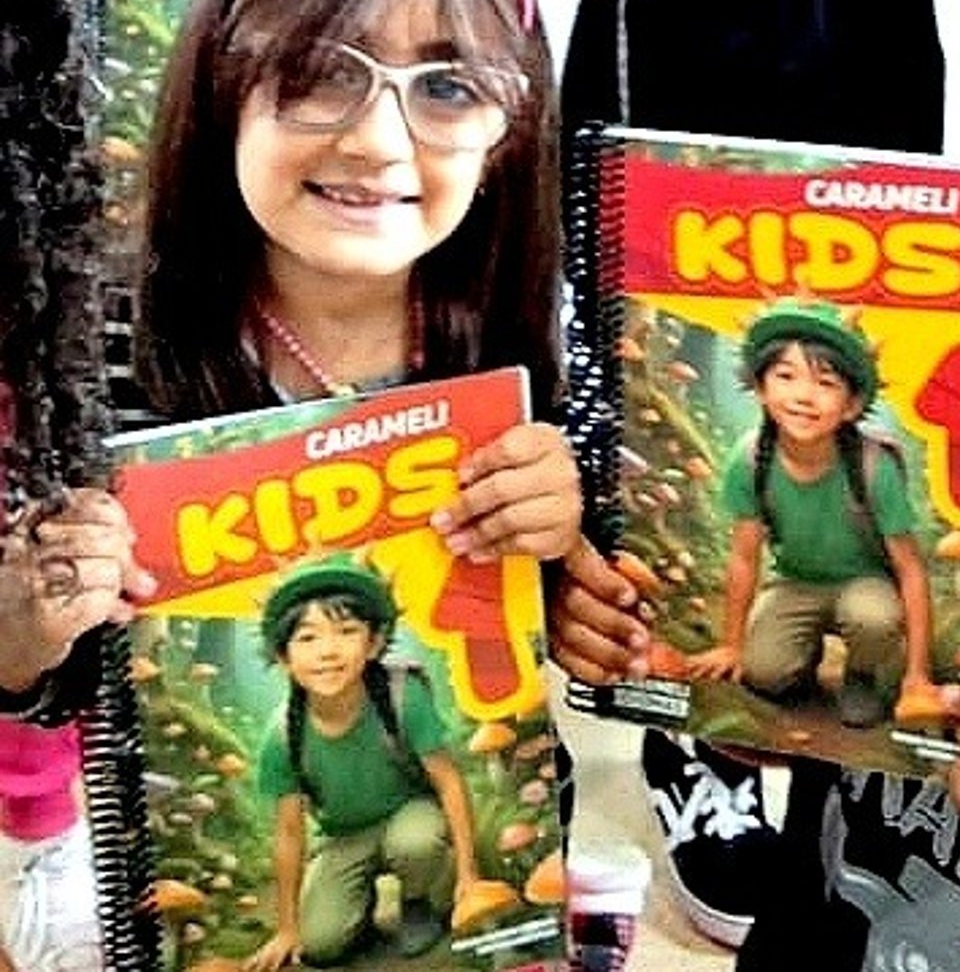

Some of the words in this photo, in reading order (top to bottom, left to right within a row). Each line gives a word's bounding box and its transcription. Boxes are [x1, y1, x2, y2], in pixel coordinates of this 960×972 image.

[305, 400, 450, 459] CARAMELI
[177, 435, 463, 577] KIDS
[431, 553, 522, 704] 1
